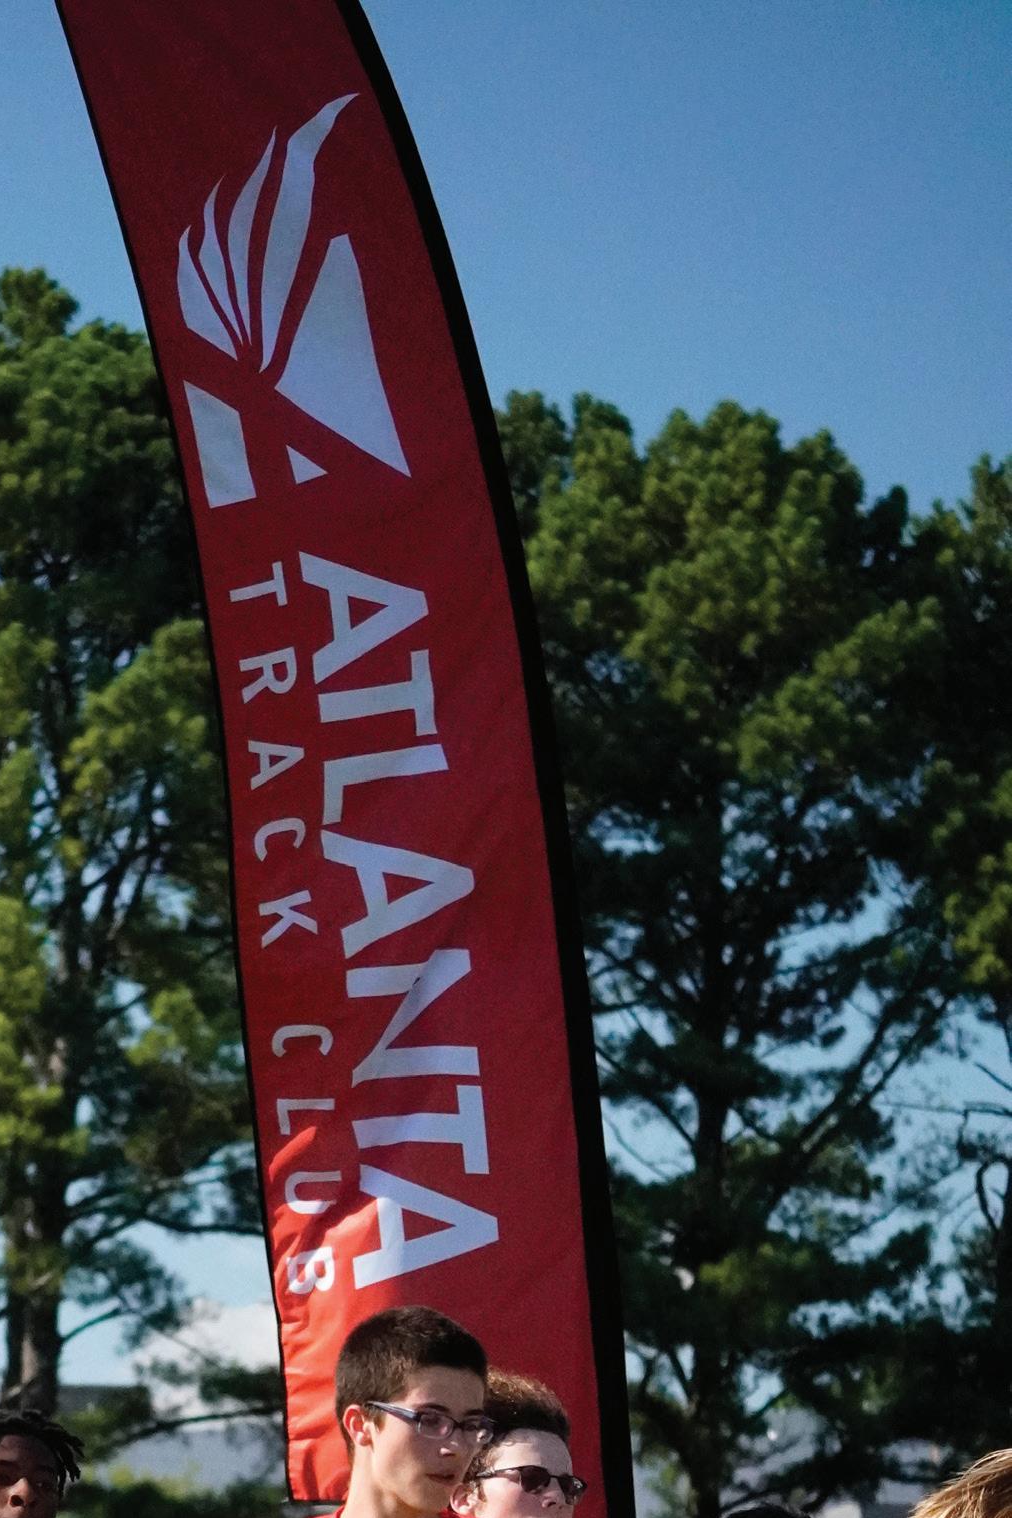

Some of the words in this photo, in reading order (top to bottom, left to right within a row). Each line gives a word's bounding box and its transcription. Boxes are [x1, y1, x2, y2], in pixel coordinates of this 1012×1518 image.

[229, 561, 318, 949] TRACK
[298, 551, 499, 1290] ATLANTA
[271, 1024, 342, 1295] CLUB
